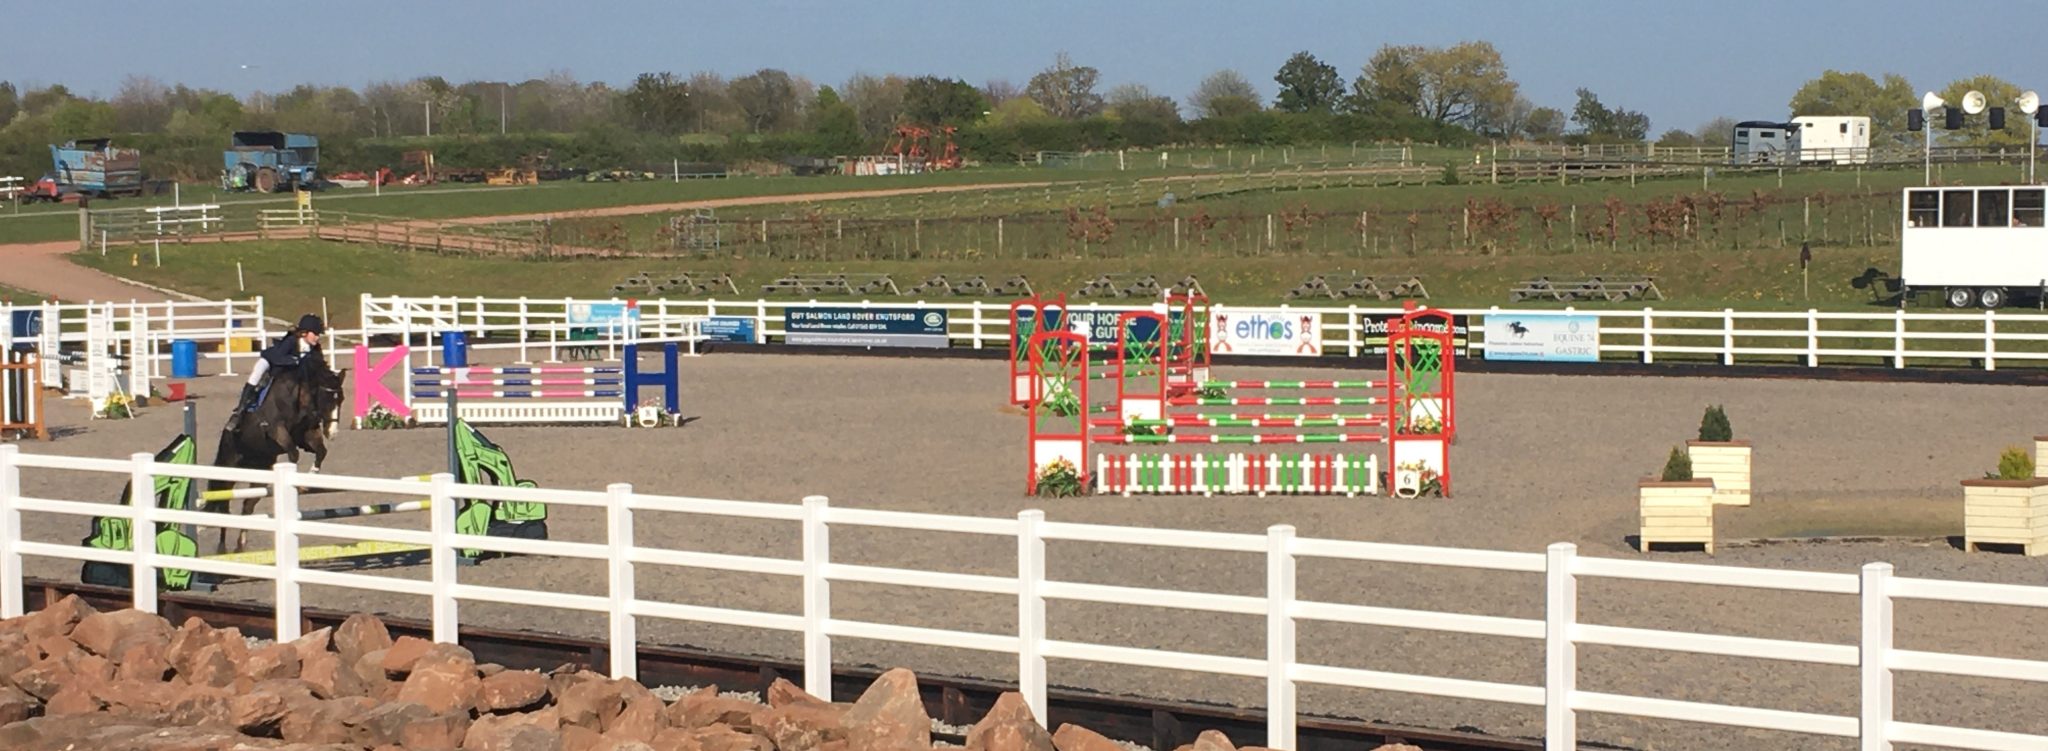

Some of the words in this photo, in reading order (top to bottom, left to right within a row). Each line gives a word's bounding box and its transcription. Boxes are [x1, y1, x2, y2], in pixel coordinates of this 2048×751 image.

[791, 312, 804, 320] GUY
[806, 312, 832, 320] SALMON
[834, 312, 851, 321] LAND
[852, 312, 874, 321] ROVER
[875, 313, 916, 321] KNUTSFORD
[1066, 312, 1095, 326] YOUR
[1236, 314, 1293, 340] ethos
[1555, 346, 1592, 355] GASTRIC
[354, 344, 410, 417] K
[625, 342, 679, 414] H
[1403, 474, 1412, 486] 6
